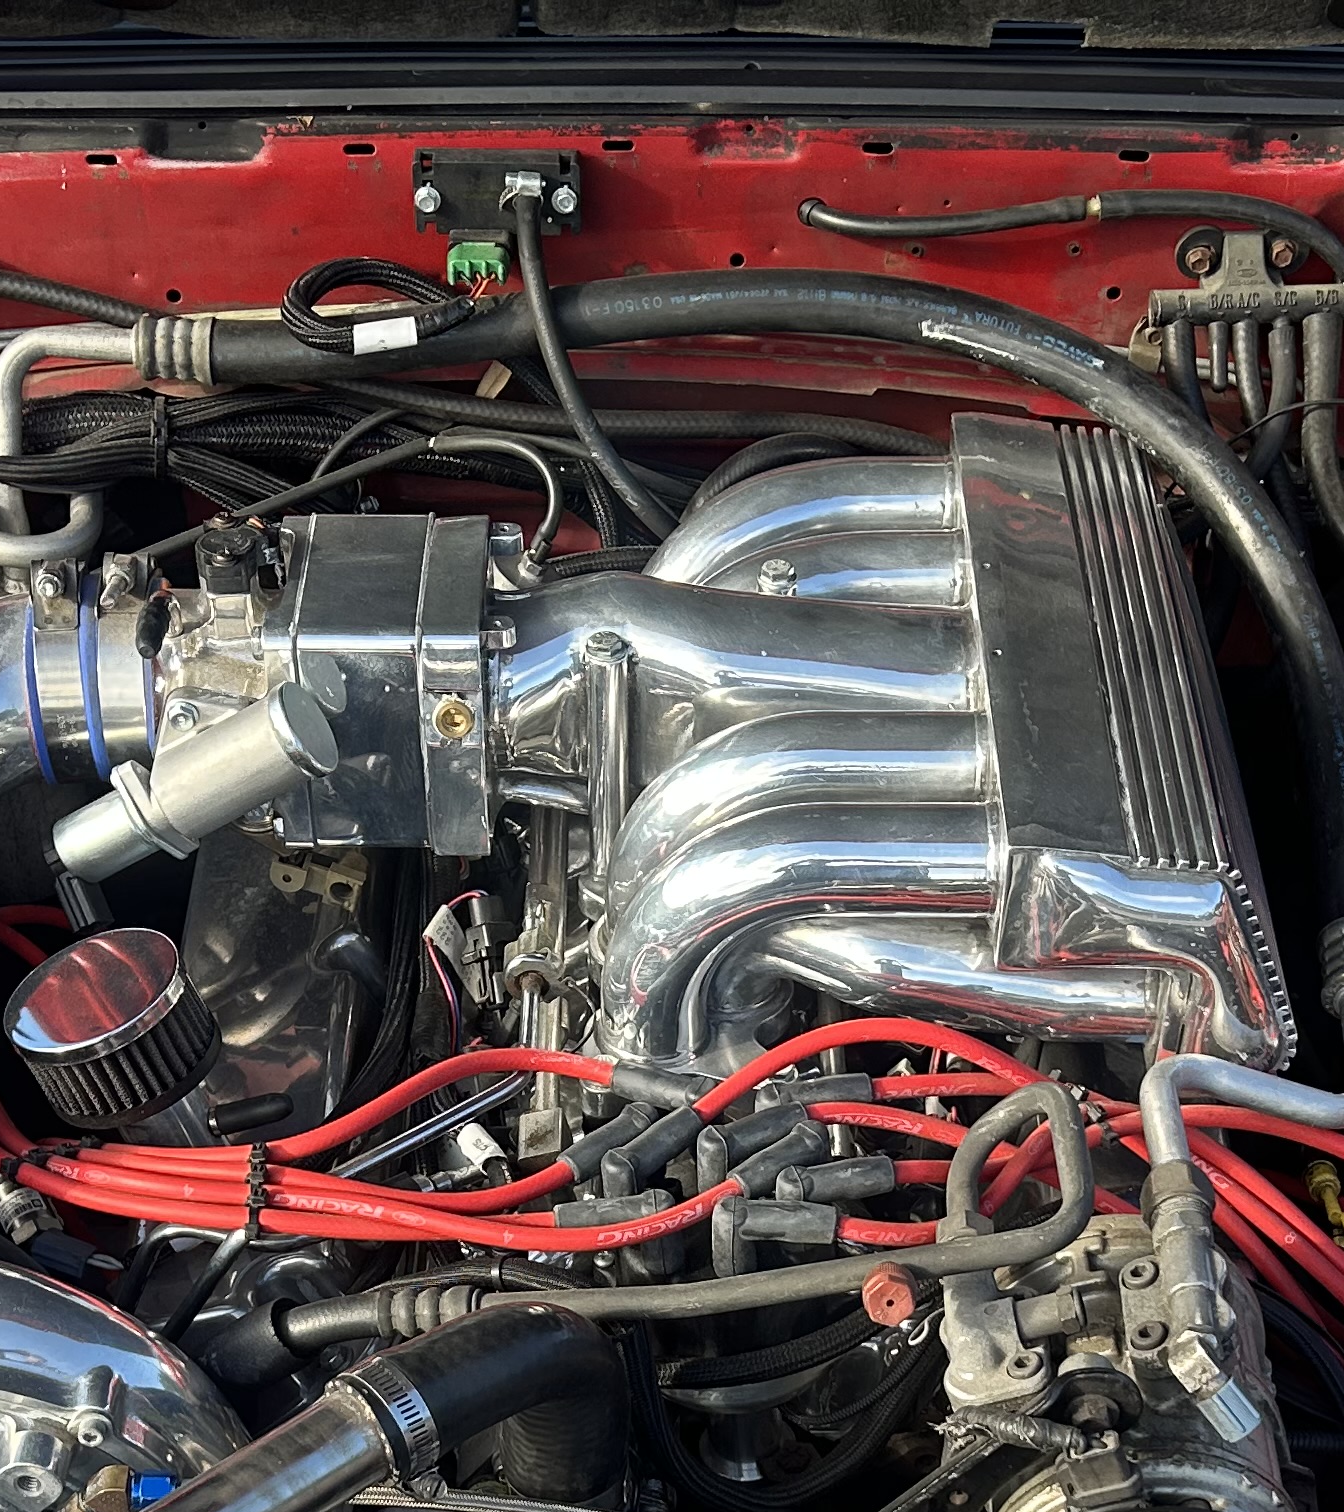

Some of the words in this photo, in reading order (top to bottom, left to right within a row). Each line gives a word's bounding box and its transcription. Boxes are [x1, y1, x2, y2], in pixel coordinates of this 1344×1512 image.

[1237, 293, 1261, 309] A/C
[975, 311, 1021, 335] FUTURA
[183, 1184, 194, 1198] 4
[272, 1193, 384, 1219] RACING
[596, 1202, 703, 1246] RACING
[503, 1230, 514, 1244] 4
